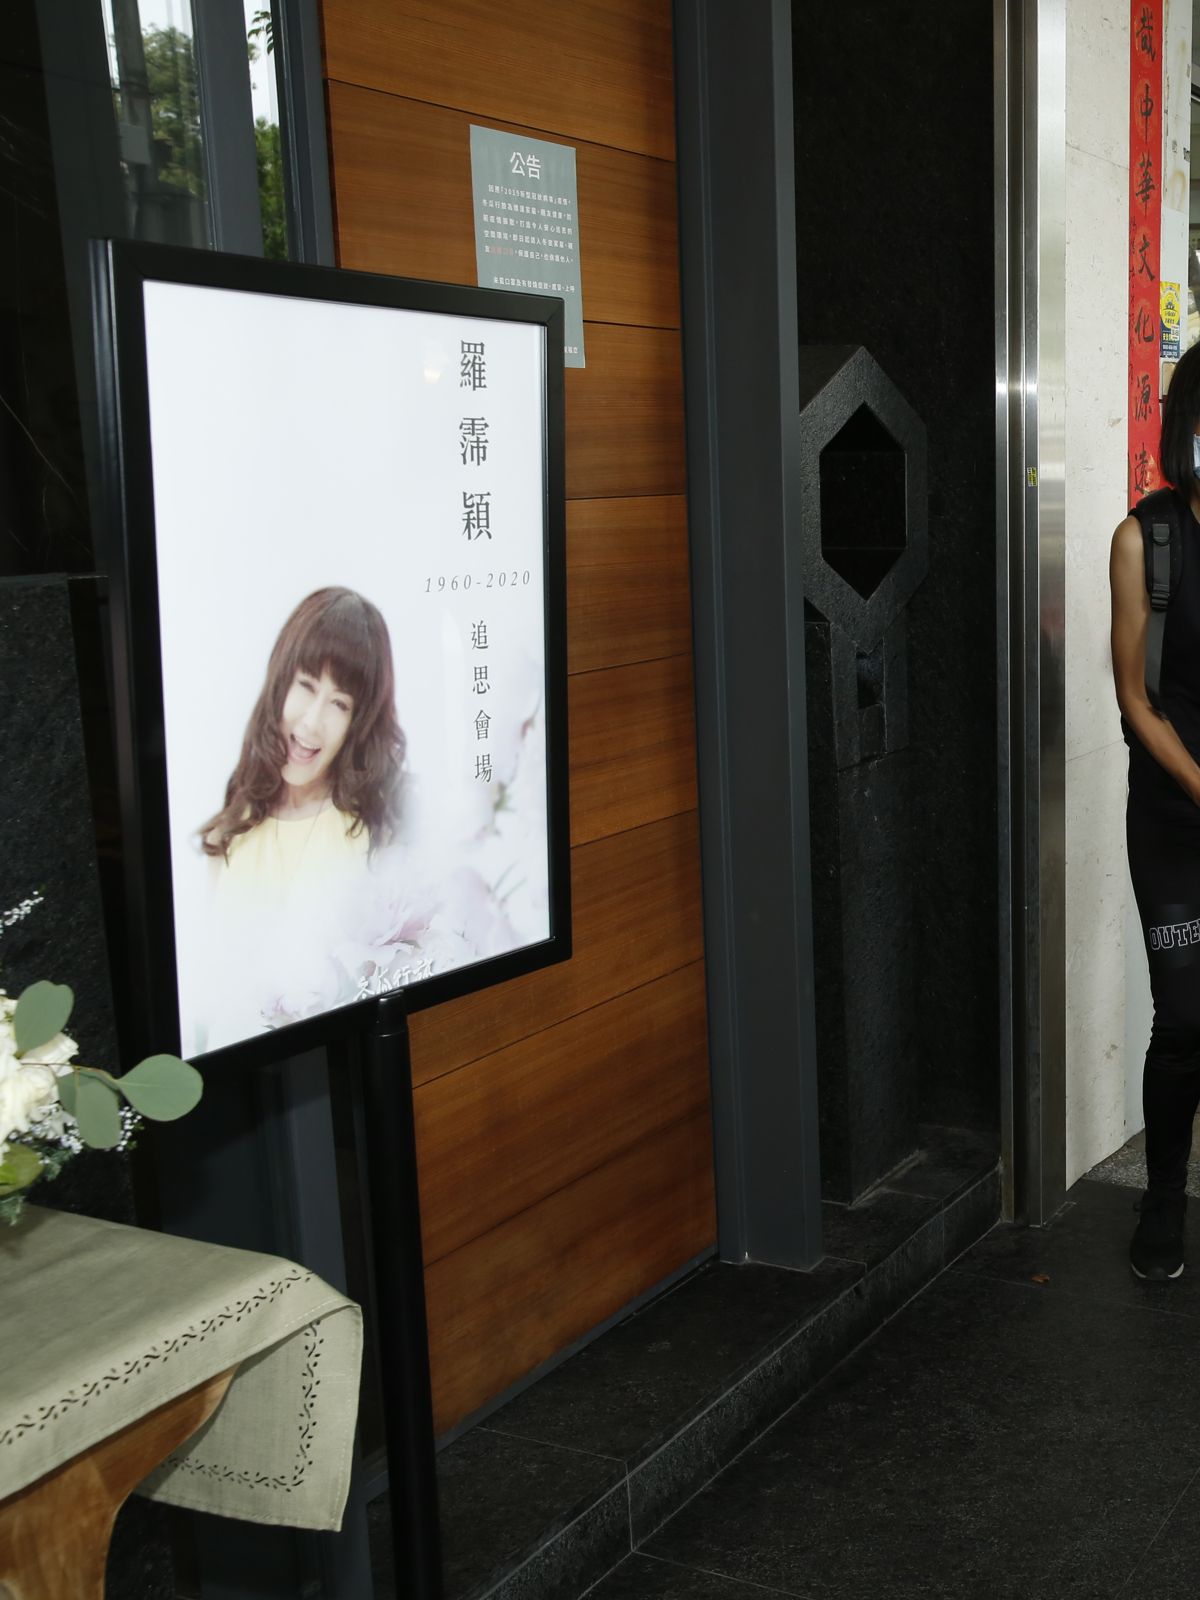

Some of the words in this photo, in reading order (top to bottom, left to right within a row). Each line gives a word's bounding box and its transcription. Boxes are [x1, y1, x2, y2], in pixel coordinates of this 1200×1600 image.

[509, 151, 542, 180] 公告
[458, 339, 493, 541] 羅霈穎
[424, 570, 531, 593] 1960-2020
[470, 619, 493, 784] 追思會場
